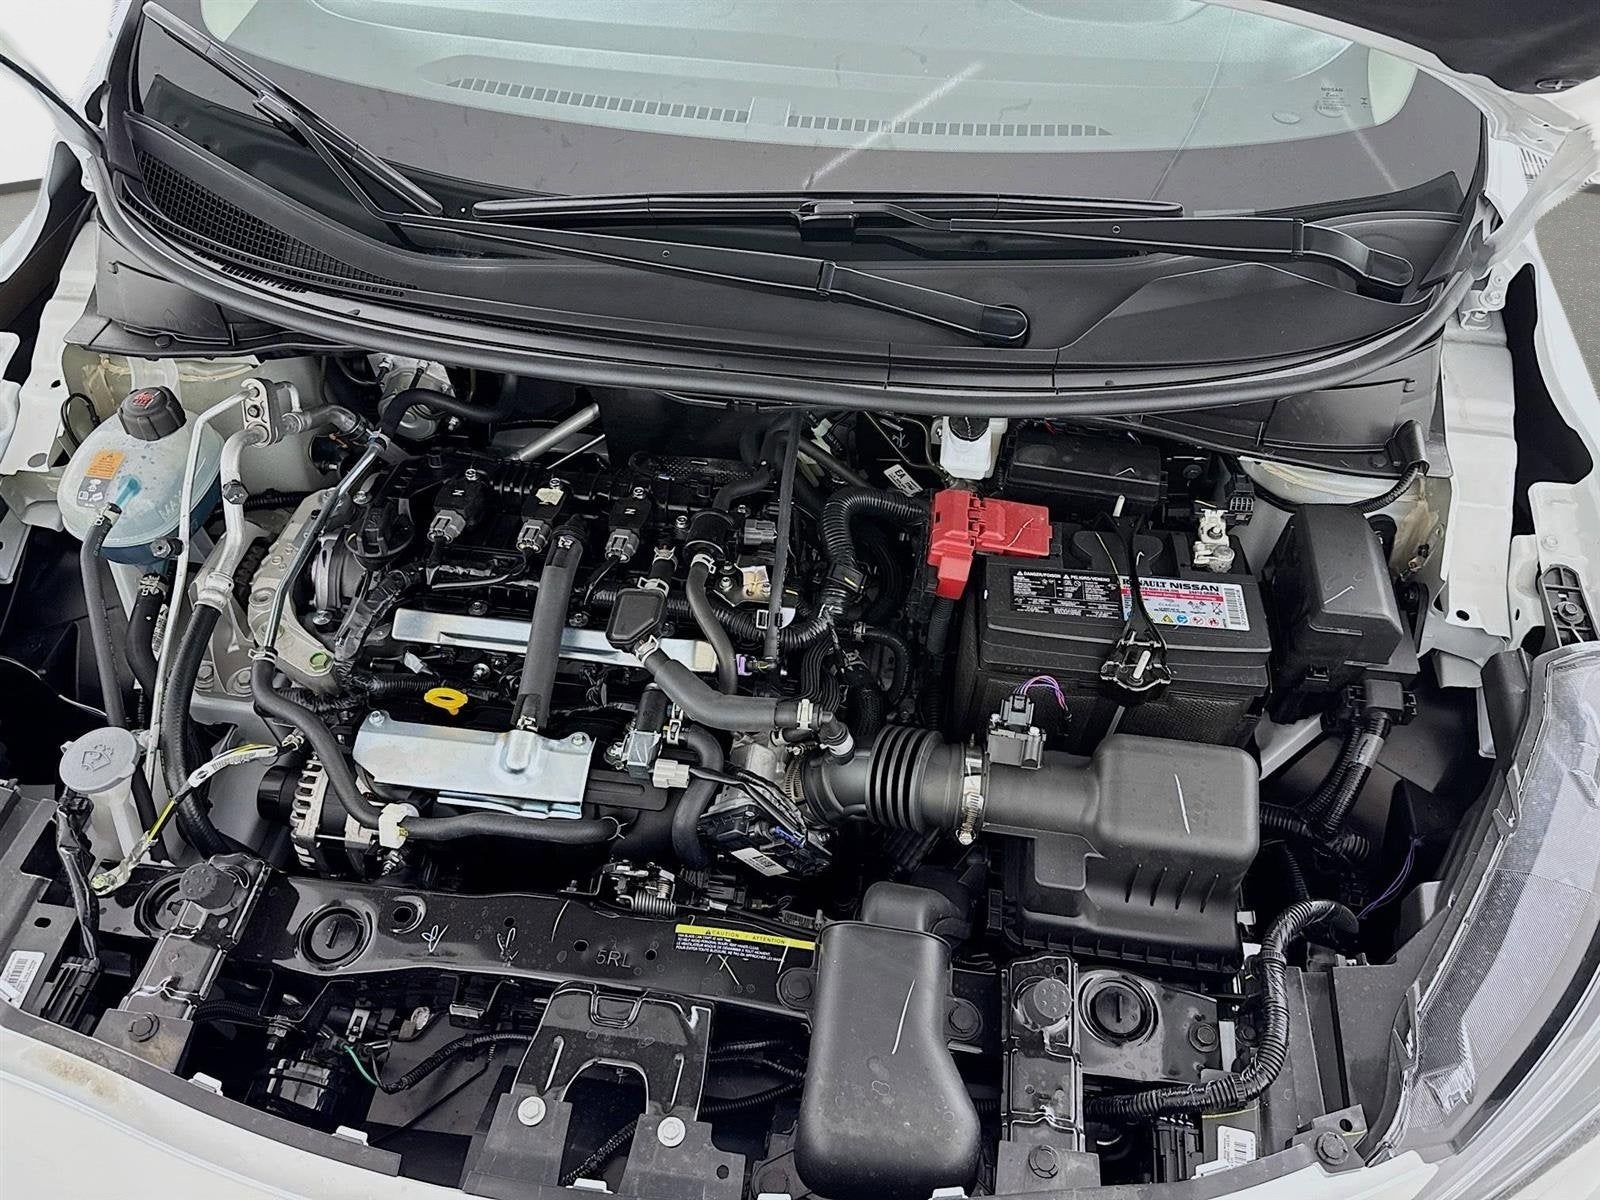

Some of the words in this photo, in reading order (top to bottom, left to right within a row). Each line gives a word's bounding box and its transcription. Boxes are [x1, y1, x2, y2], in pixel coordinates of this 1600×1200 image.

[1122, 578, 1167, 587] RNAULT
[1170, 582, 1219, 592] NISSAN
[752, 936, 785, 944] ATTENTION
[595, 949, 631, 968] 5RL
